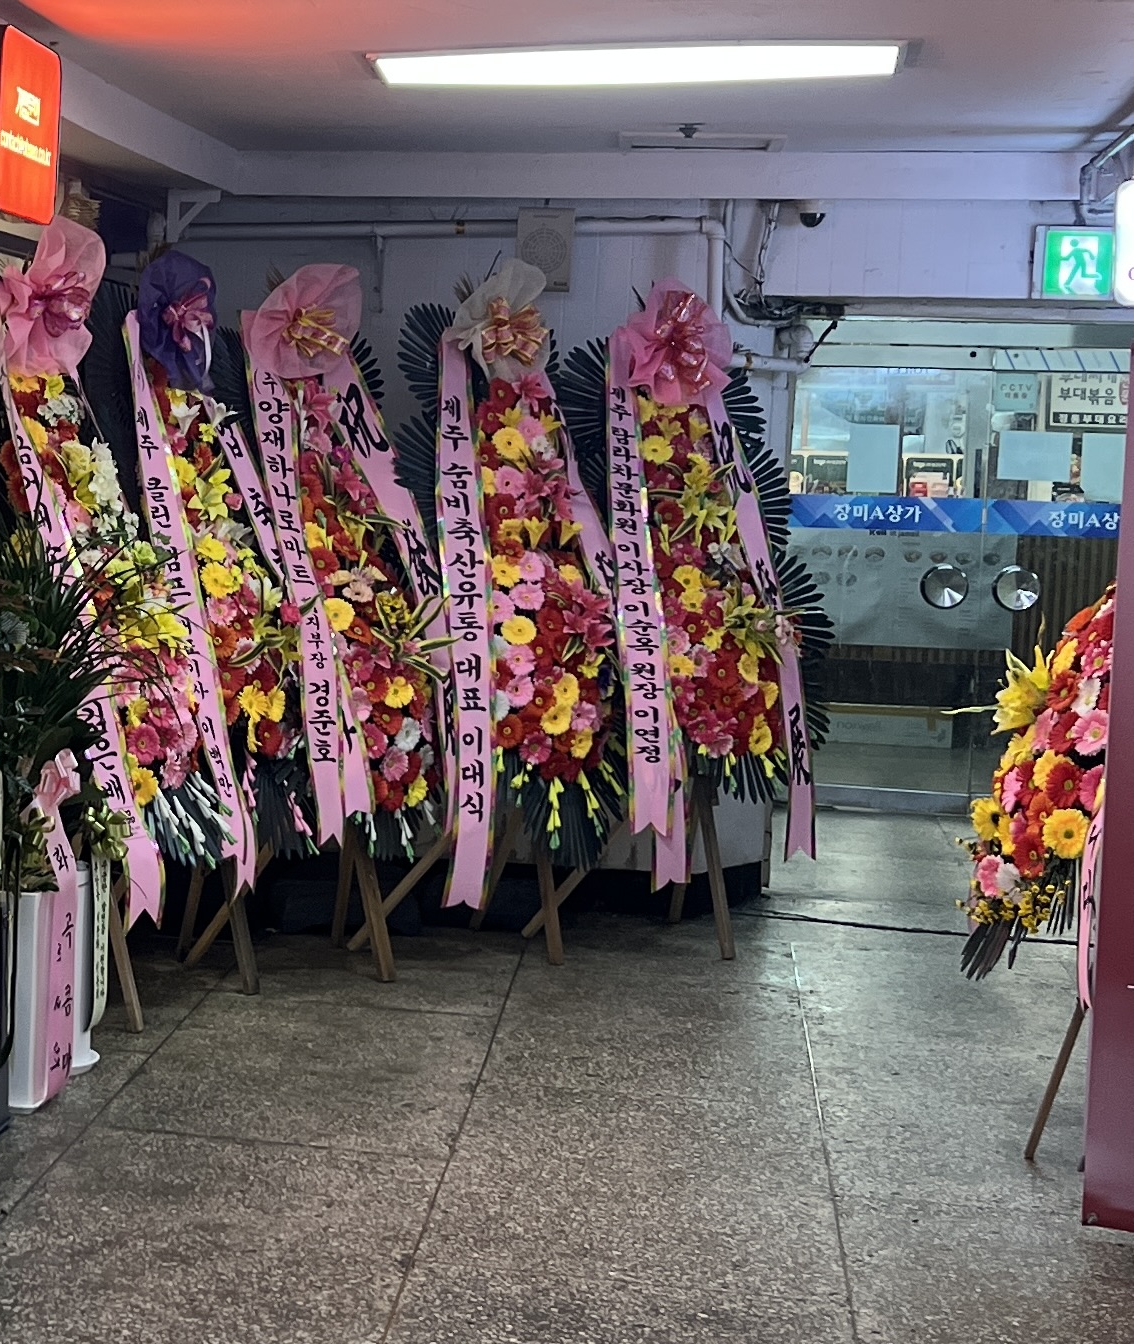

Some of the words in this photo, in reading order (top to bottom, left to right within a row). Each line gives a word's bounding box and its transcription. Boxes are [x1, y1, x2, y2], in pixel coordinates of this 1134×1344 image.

[999, 383, 1033, 391] CCTV
[1058, 387, 1117, 406] 부대볶음
[441, 395, 469, 452] 제주
[834, 504, 922, 523] 장미A상가
[1049, 511, 1121, 531] 장미A상
[617, 541, 654, 595] 이사장
[455, 653, 487, 713] 대표
[631, 662, 665, 700] 원장
[460, 726, 486, 823] 이대식
